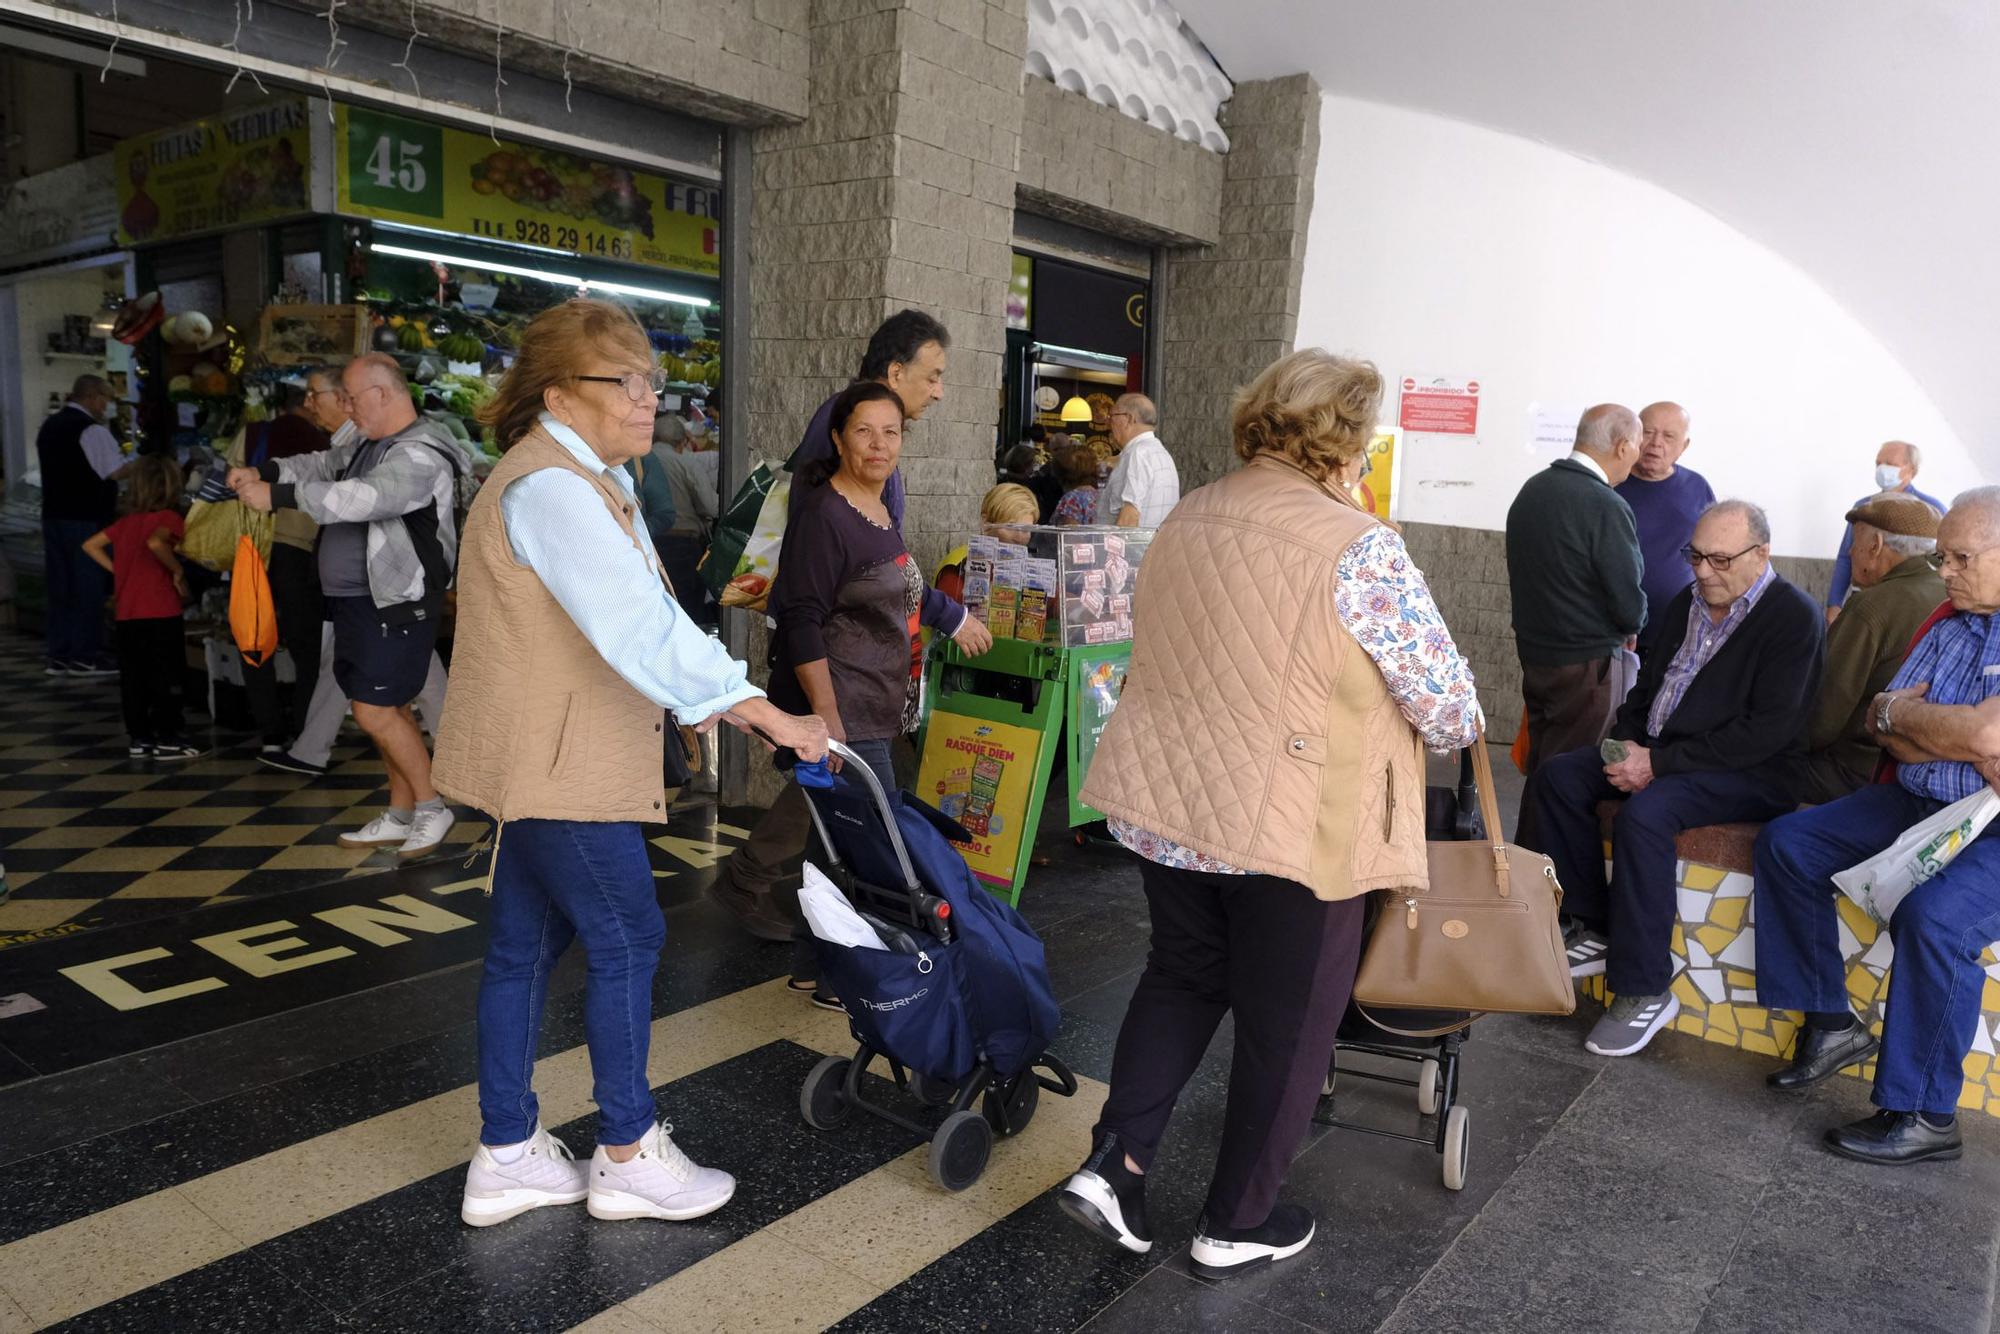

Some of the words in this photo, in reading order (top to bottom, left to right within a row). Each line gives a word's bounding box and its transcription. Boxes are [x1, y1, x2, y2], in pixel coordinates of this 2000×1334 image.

[365, 136, 427, 193] 45
[515, 219, 551, 245] 928
[557, 226, 579, 250] 29
[585, 232, 607, 254] 14
[611, 237, 632, 259] 63
[945, 737, 986, 756] RASQUE
[988, 747, 1015, 762] DIEM
[859, 987, 929, 1013] THERMO
